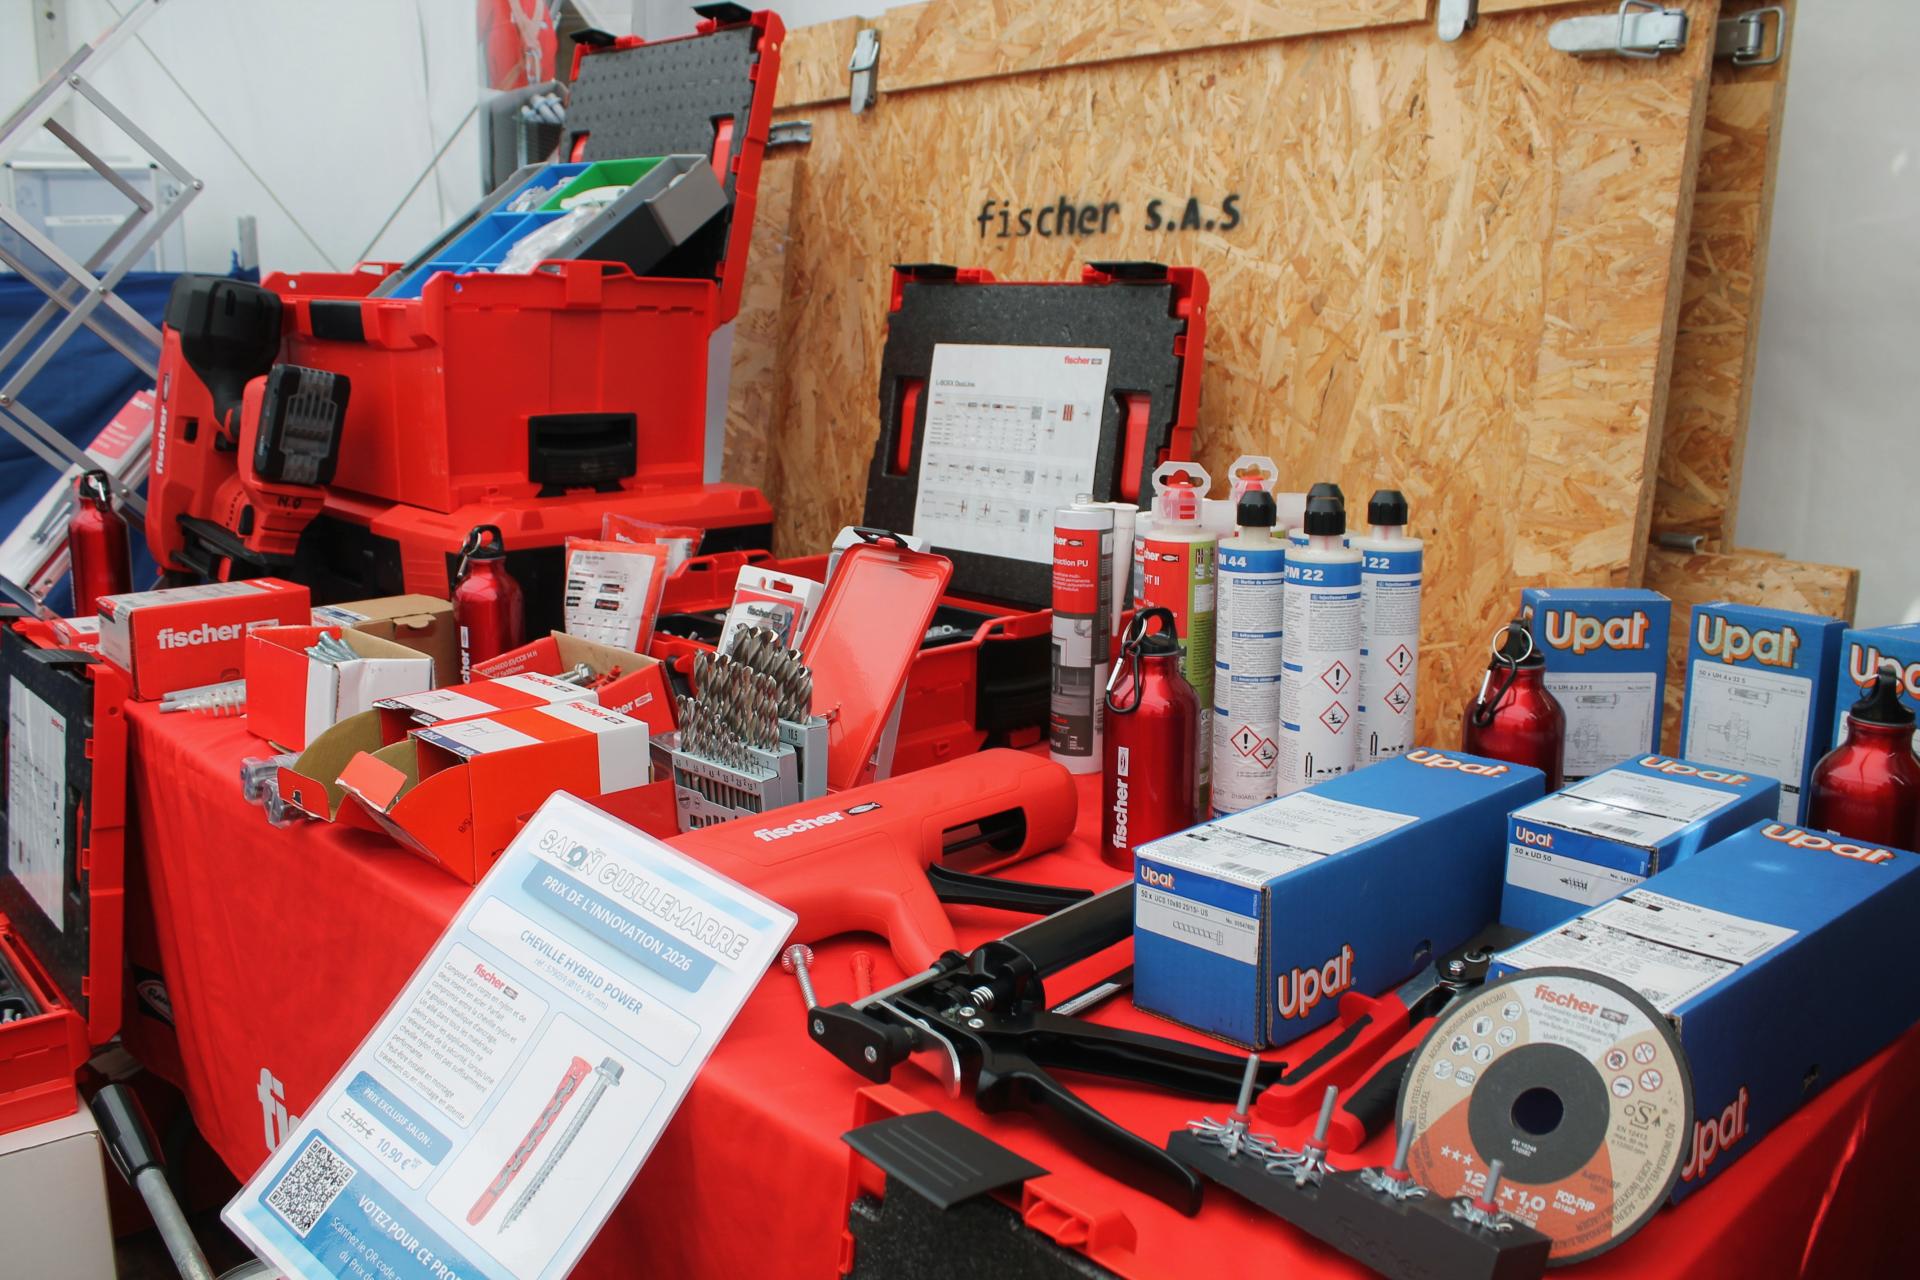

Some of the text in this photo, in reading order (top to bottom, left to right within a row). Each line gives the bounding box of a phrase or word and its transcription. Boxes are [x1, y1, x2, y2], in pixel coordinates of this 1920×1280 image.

[977, 194, 1240, 239] fischer S.A.S
[1064, 355, 1090, 365] fischer
[156, 406, 168, 475] fischer
[1229, 556, 1248, 568] 44
[1302, 569, 1324, 582] 22
[1369, 557, 1390, 570] 22
[747, 605, 771, 619] fischer
[157, 623, 242, 649] fischer
[1545, 609, 1649, 655] Upat
[1697, 613, 1799, 669] Upat
[460, 650, 470, 685] cher
[521, 674, 556, 688] fischer
[568, 702, 608, 718] fischer
[1405, 749, 1510, 778] Upat
[1638, 754, 1750, 786] Upat
[754, 811, 844, 842] fischer
[1112, 778, 1129, 848] fischer
[1515, 825, 1553, 848] Upat
[1760, 822, 1896, 866] Upat
[1530, 851, 1542, 859] UD
[1139, 864, 1175, 889] Upat
[541, 826, 748, 962] SALON GUILLEMARRE
[543, 875, 692, 972] PRIX DE L'INNOVATION 2026
[474, 962, 506, 990] fischer
[520, 929, 643, 1014] CHEVILLE HYBRID POWER
[1277, 944, 1354, 1019] Upat
[1533, 983, 1600, 1015] fischer
[363, 1087, 379, 1103] PRIX
[378, 1099, 408, 1126] EXCLUSIF
[406, 1122, 430, 1144] SALON
[376, 1137, 404, 1165] 10,90
[401, 1157, 410, 1170] €
[1463, 1169, 1487, 1188] 12
[1501, 1186, 1515, 1200] x
[1517, 1190, 1547, 1213] 1,0
[358, 1195, 433, 1265] VOTEZ POUR CE
[330, 1216, 396, 1279] Scannez le QR code
[339, 1250, 366, 1276] du Prix
